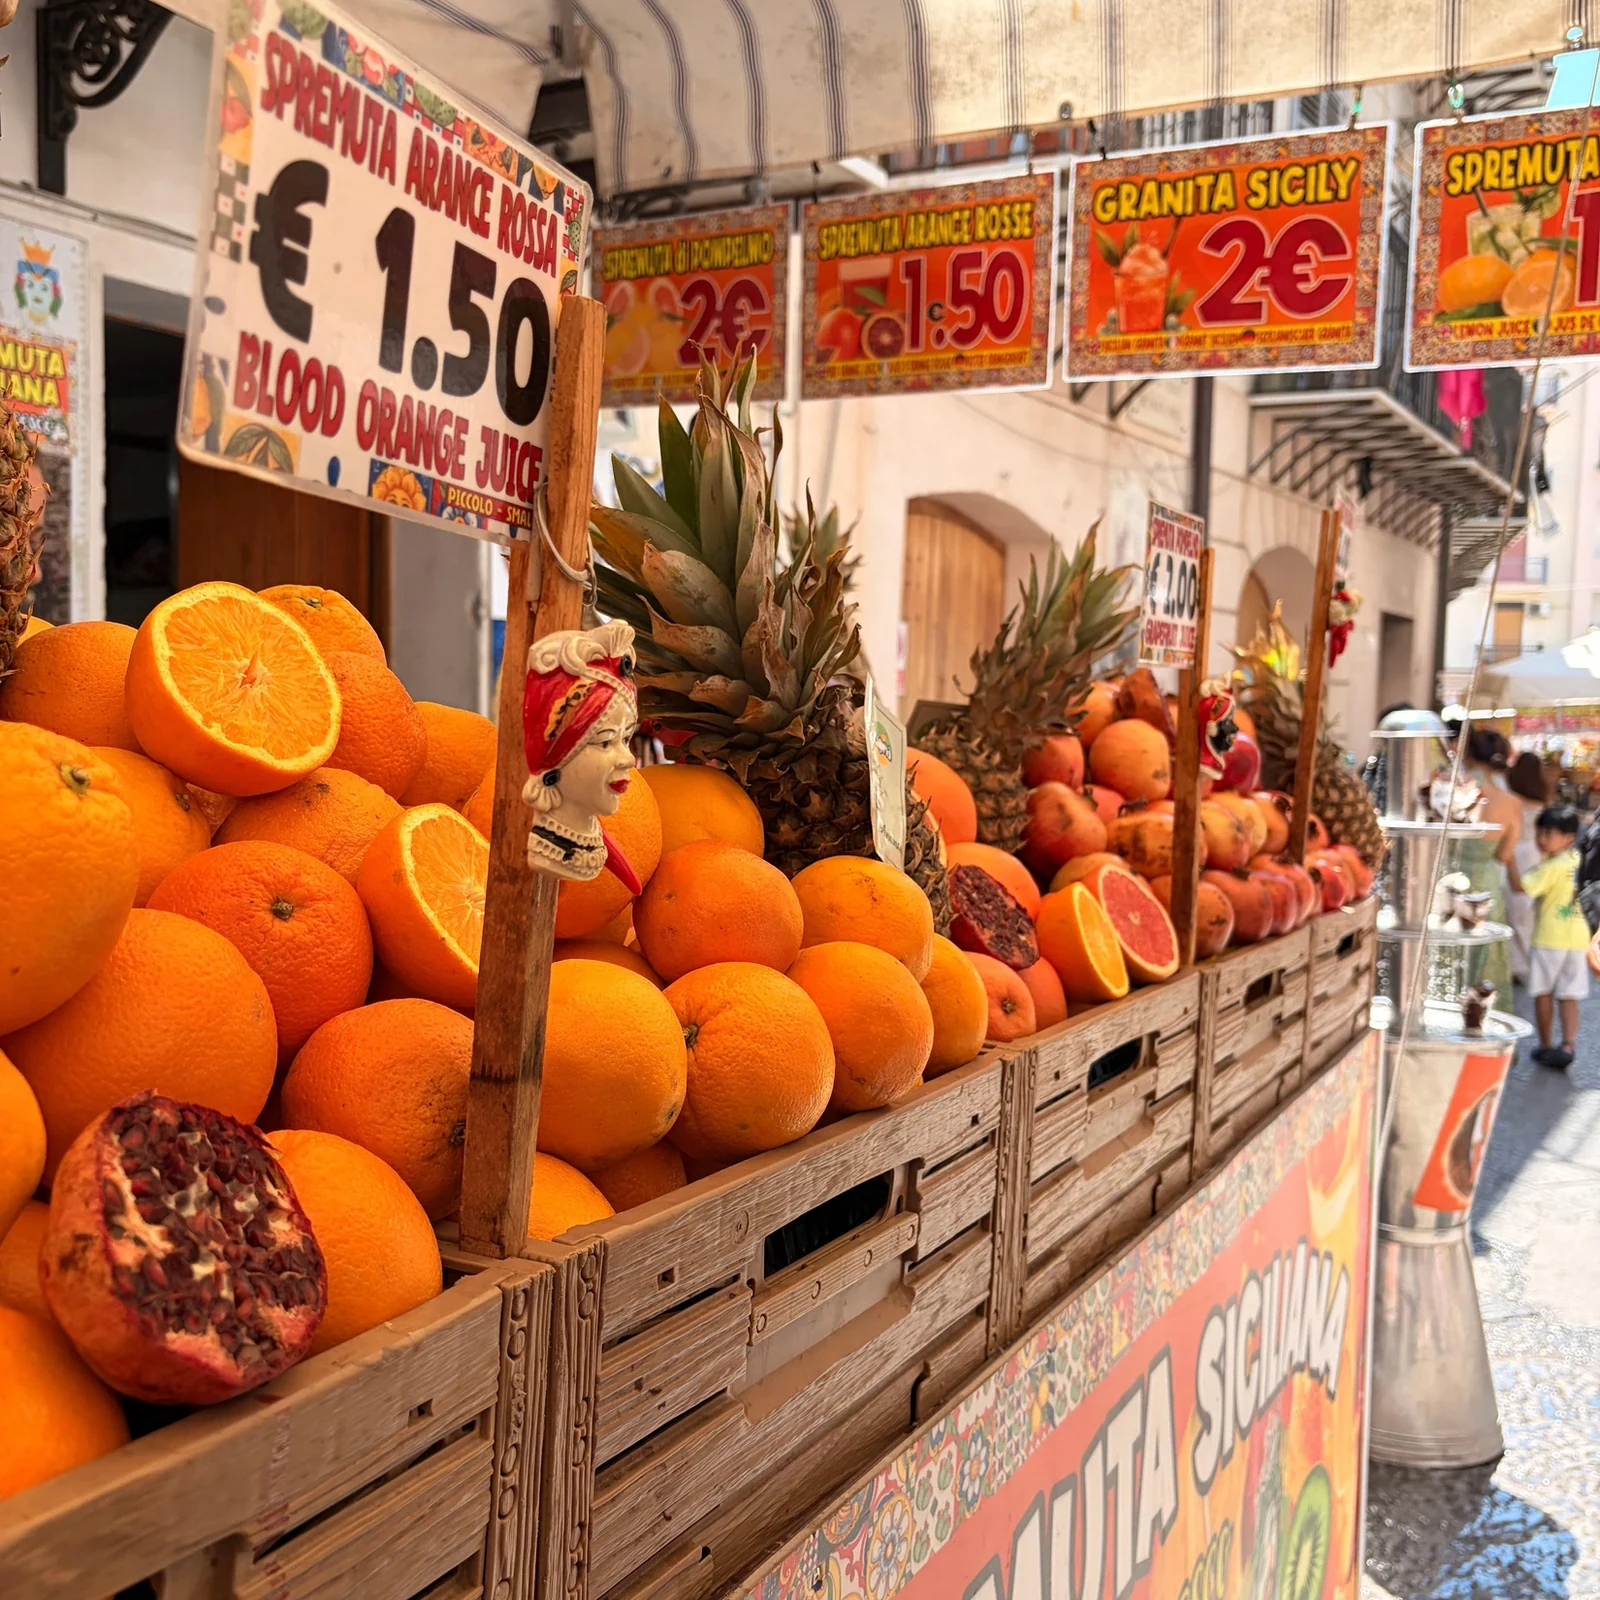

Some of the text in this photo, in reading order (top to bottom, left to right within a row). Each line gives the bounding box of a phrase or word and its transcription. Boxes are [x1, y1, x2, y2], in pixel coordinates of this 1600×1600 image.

[260, 30, 557, 278] SPREMUTA ARANCE ROSSA
[1092, 157, 1360, 223] GRANITA SICILY
[1446, 137, 1600, 195] SPREMUTA
[819, 201, 1034, 260] SPREMUTA ARANCE ROSSE
[1195, 215, 1352, 327] 2€
[249, 160, 550, 426] € 1.50
[901, 249, 1028, 351] 1.50
[1498, 319, 1531, 335] JUICE
[233, 331, 543, 504] BLOOD ORANGE JUICE
[447, 487, 493, 516] PICCOLO
[1192, 1235, 1349, 1496] SICILIANA
